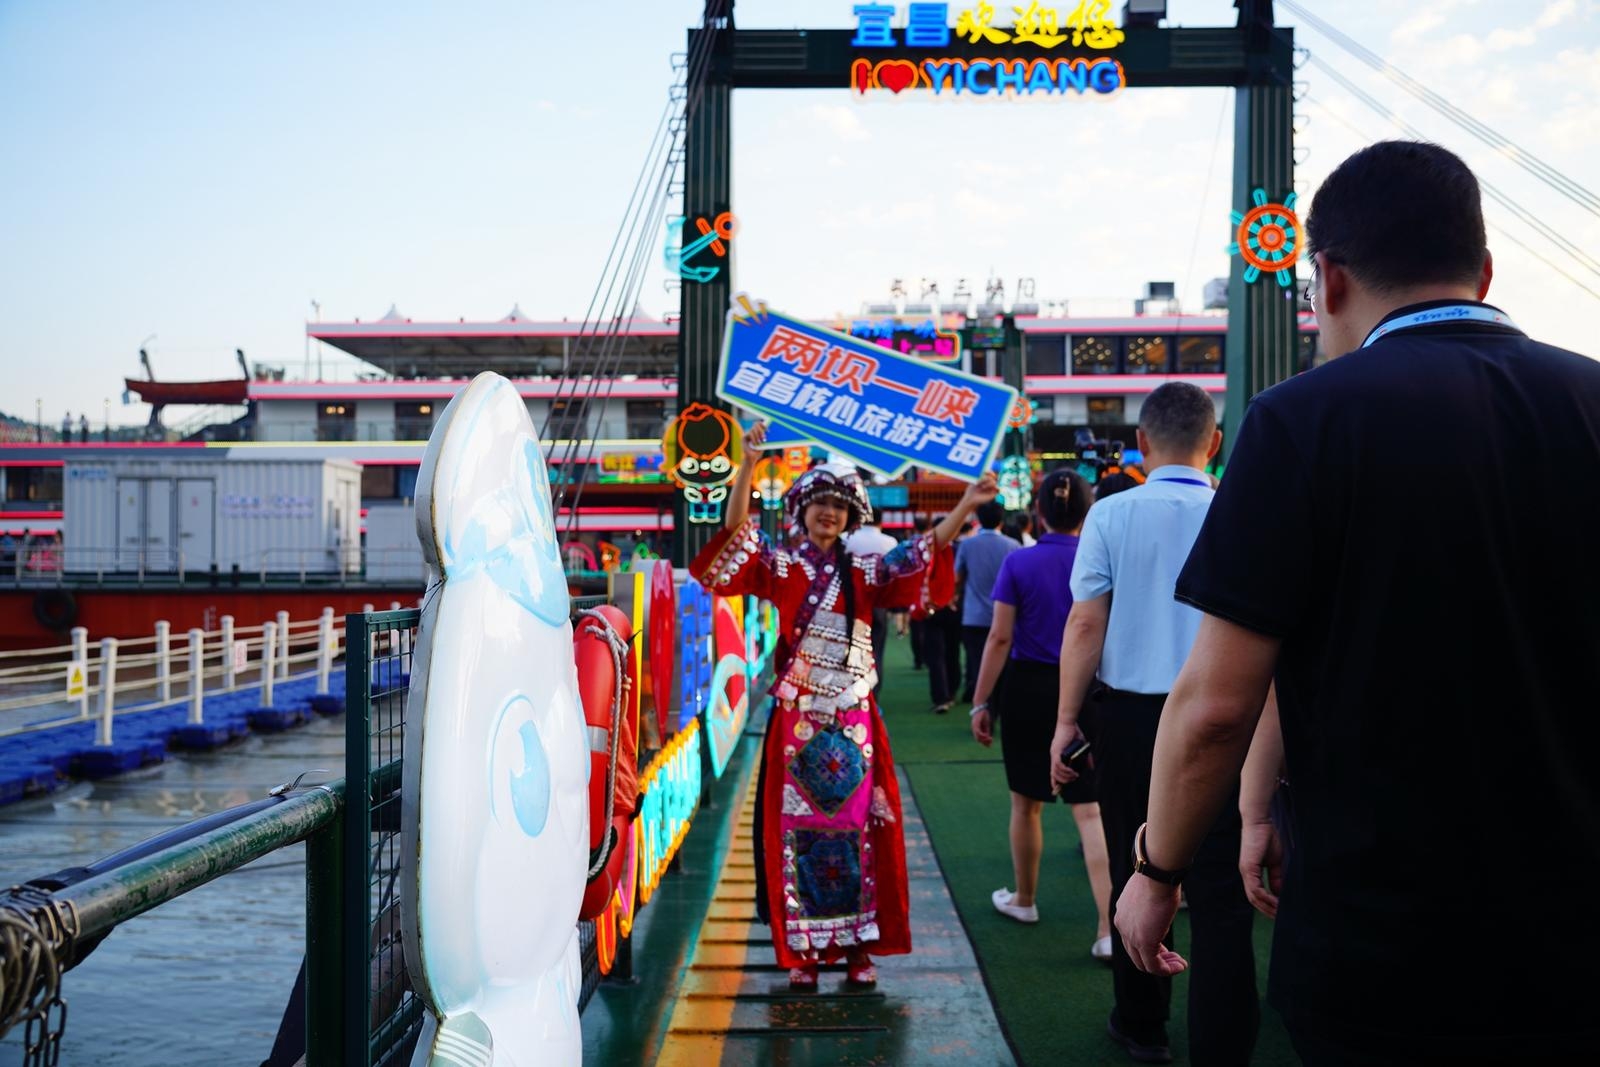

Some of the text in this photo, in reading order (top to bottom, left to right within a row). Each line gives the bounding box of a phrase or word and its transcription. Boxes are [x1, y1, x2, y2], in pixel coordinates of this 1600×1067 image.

[851, 0, 1125, 49] 宜昌欢迎您
[922, 58, 1122, 97] YICHANG
[728, 360, 989, 467] 宜昌核心旅游产品
[757, 325, 980, 427] 两坝一峡
